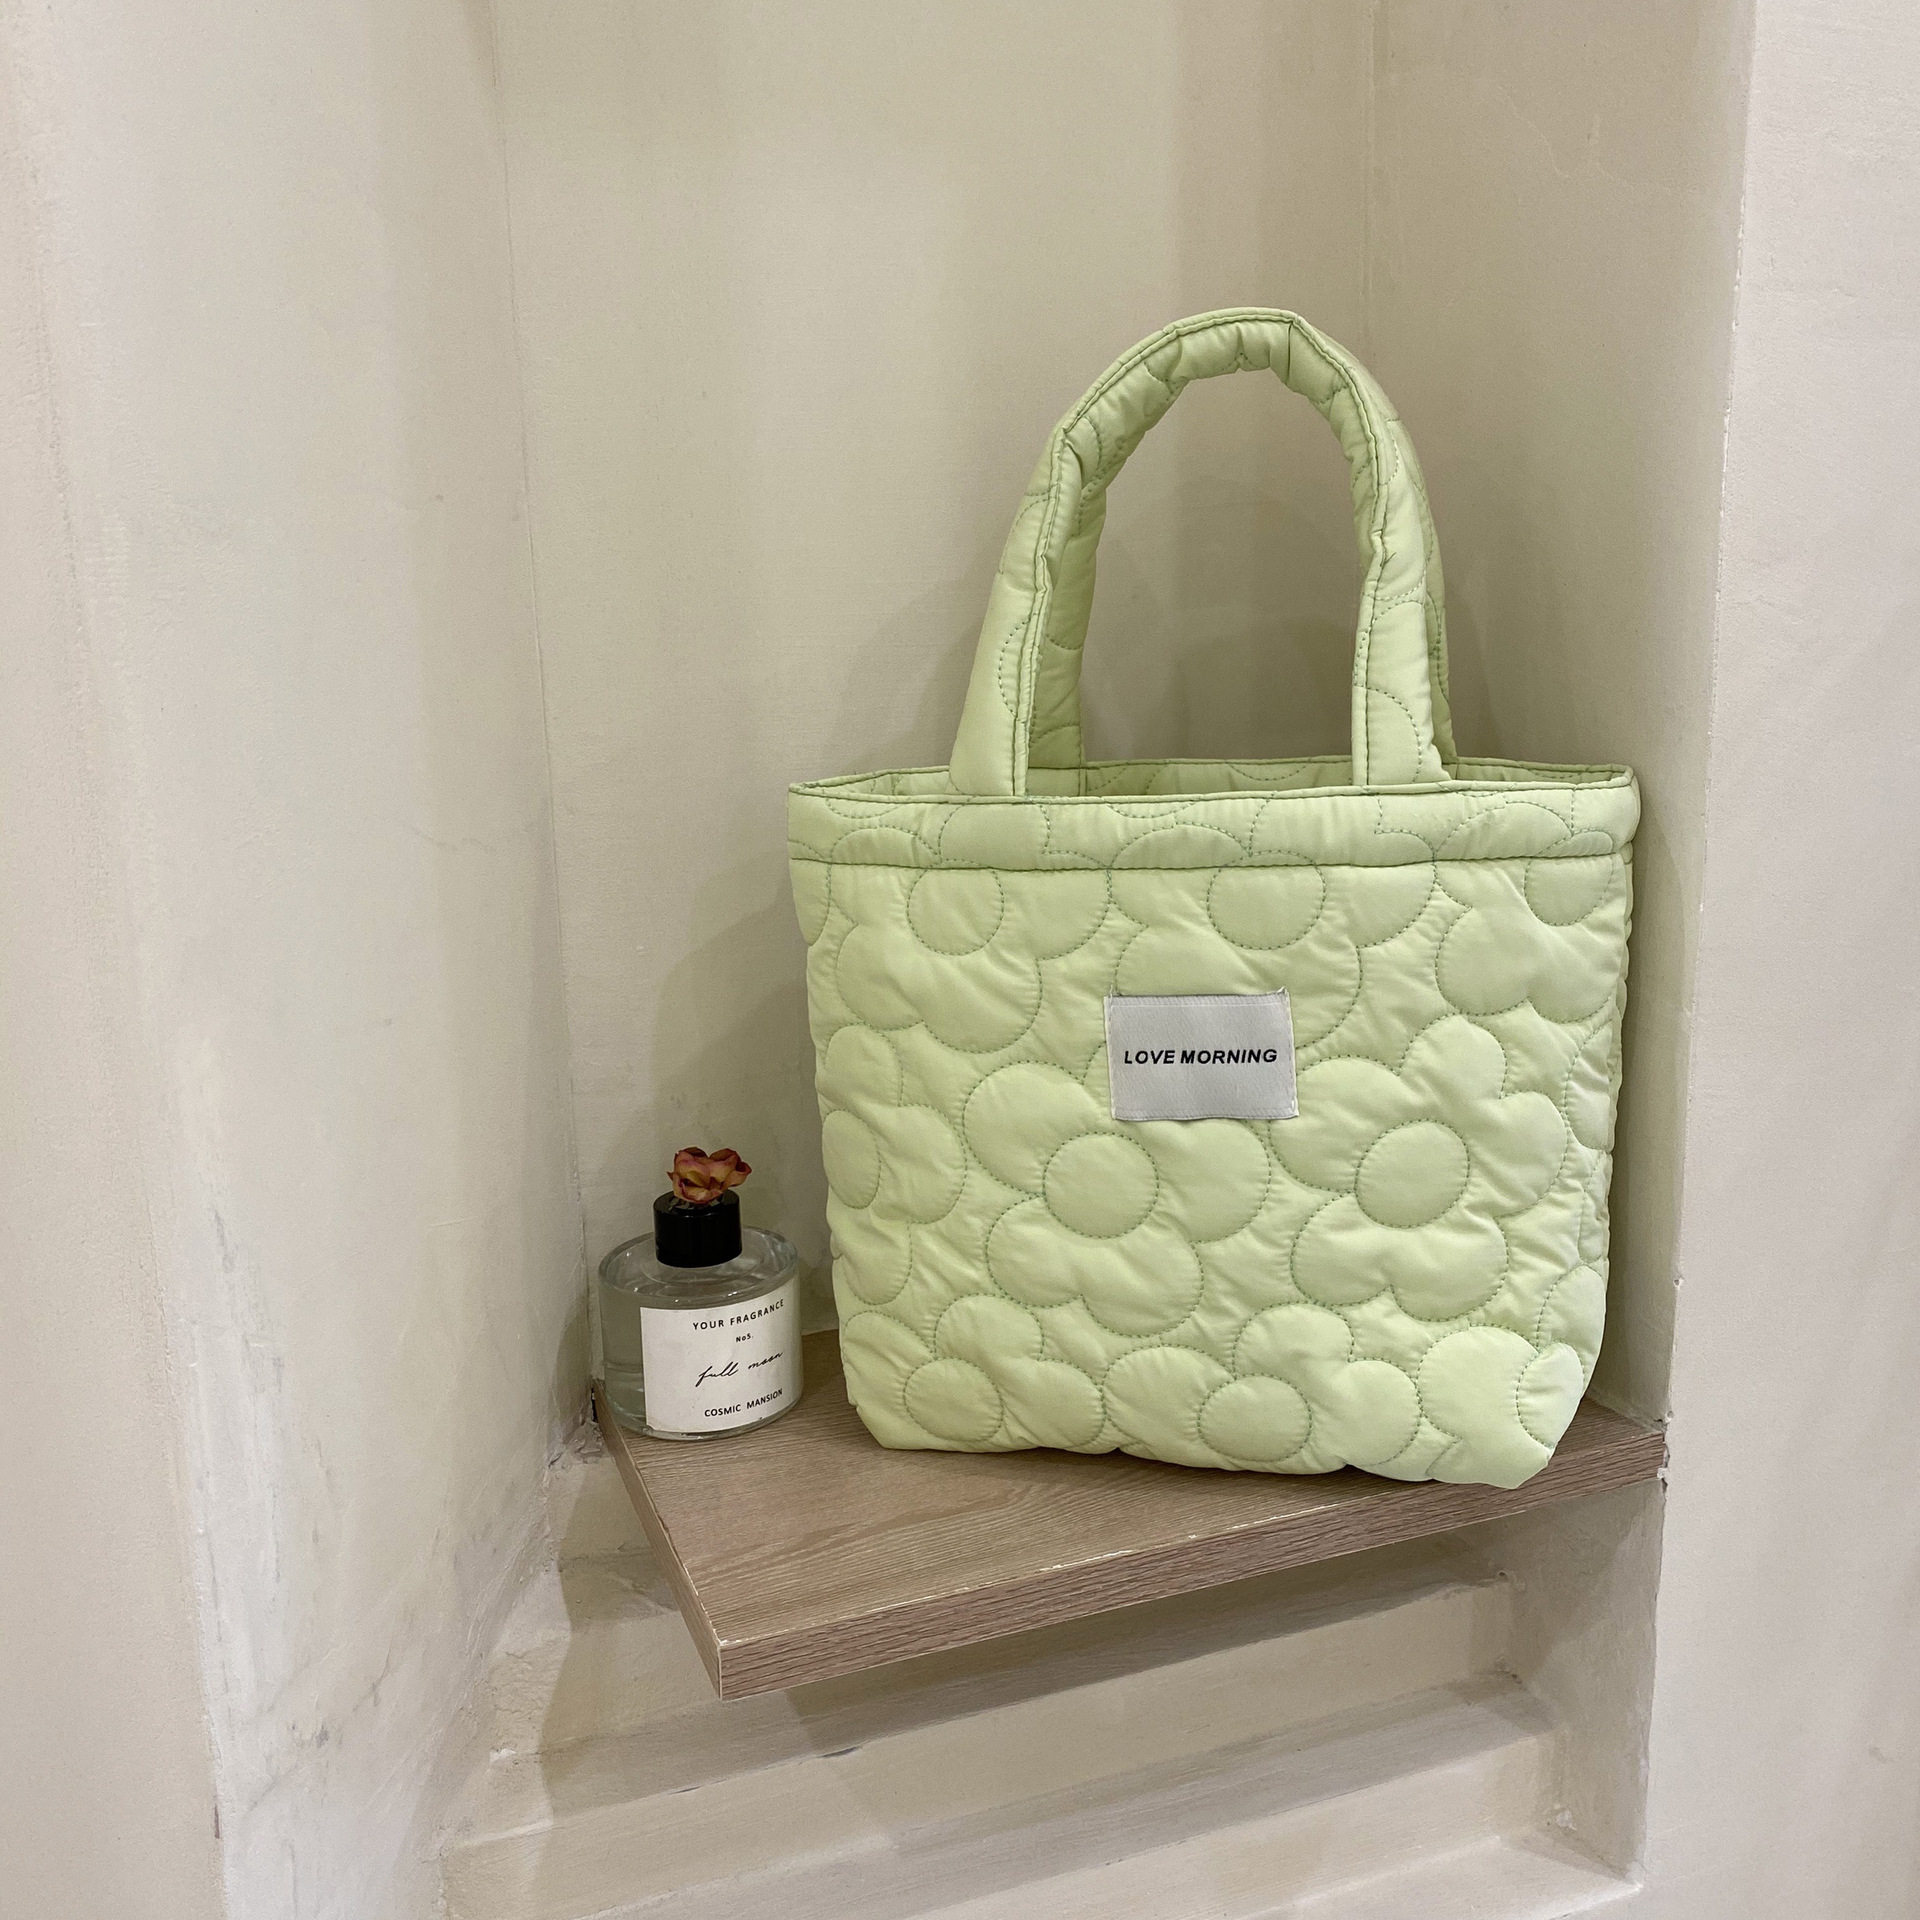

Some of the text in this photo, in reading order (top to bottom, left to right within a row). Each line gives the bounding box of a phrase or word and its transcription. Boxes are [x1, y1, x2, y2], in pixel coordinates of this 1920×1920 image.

[1124, 1049, 1278, 1065] LOVE MORNING
[692, 1298, 785, 1331] YOUR FRAGRANCE
[695, 1351, 783, 1388] full moon
[704, 1388, 783, 1418] COSMIC MANSION
